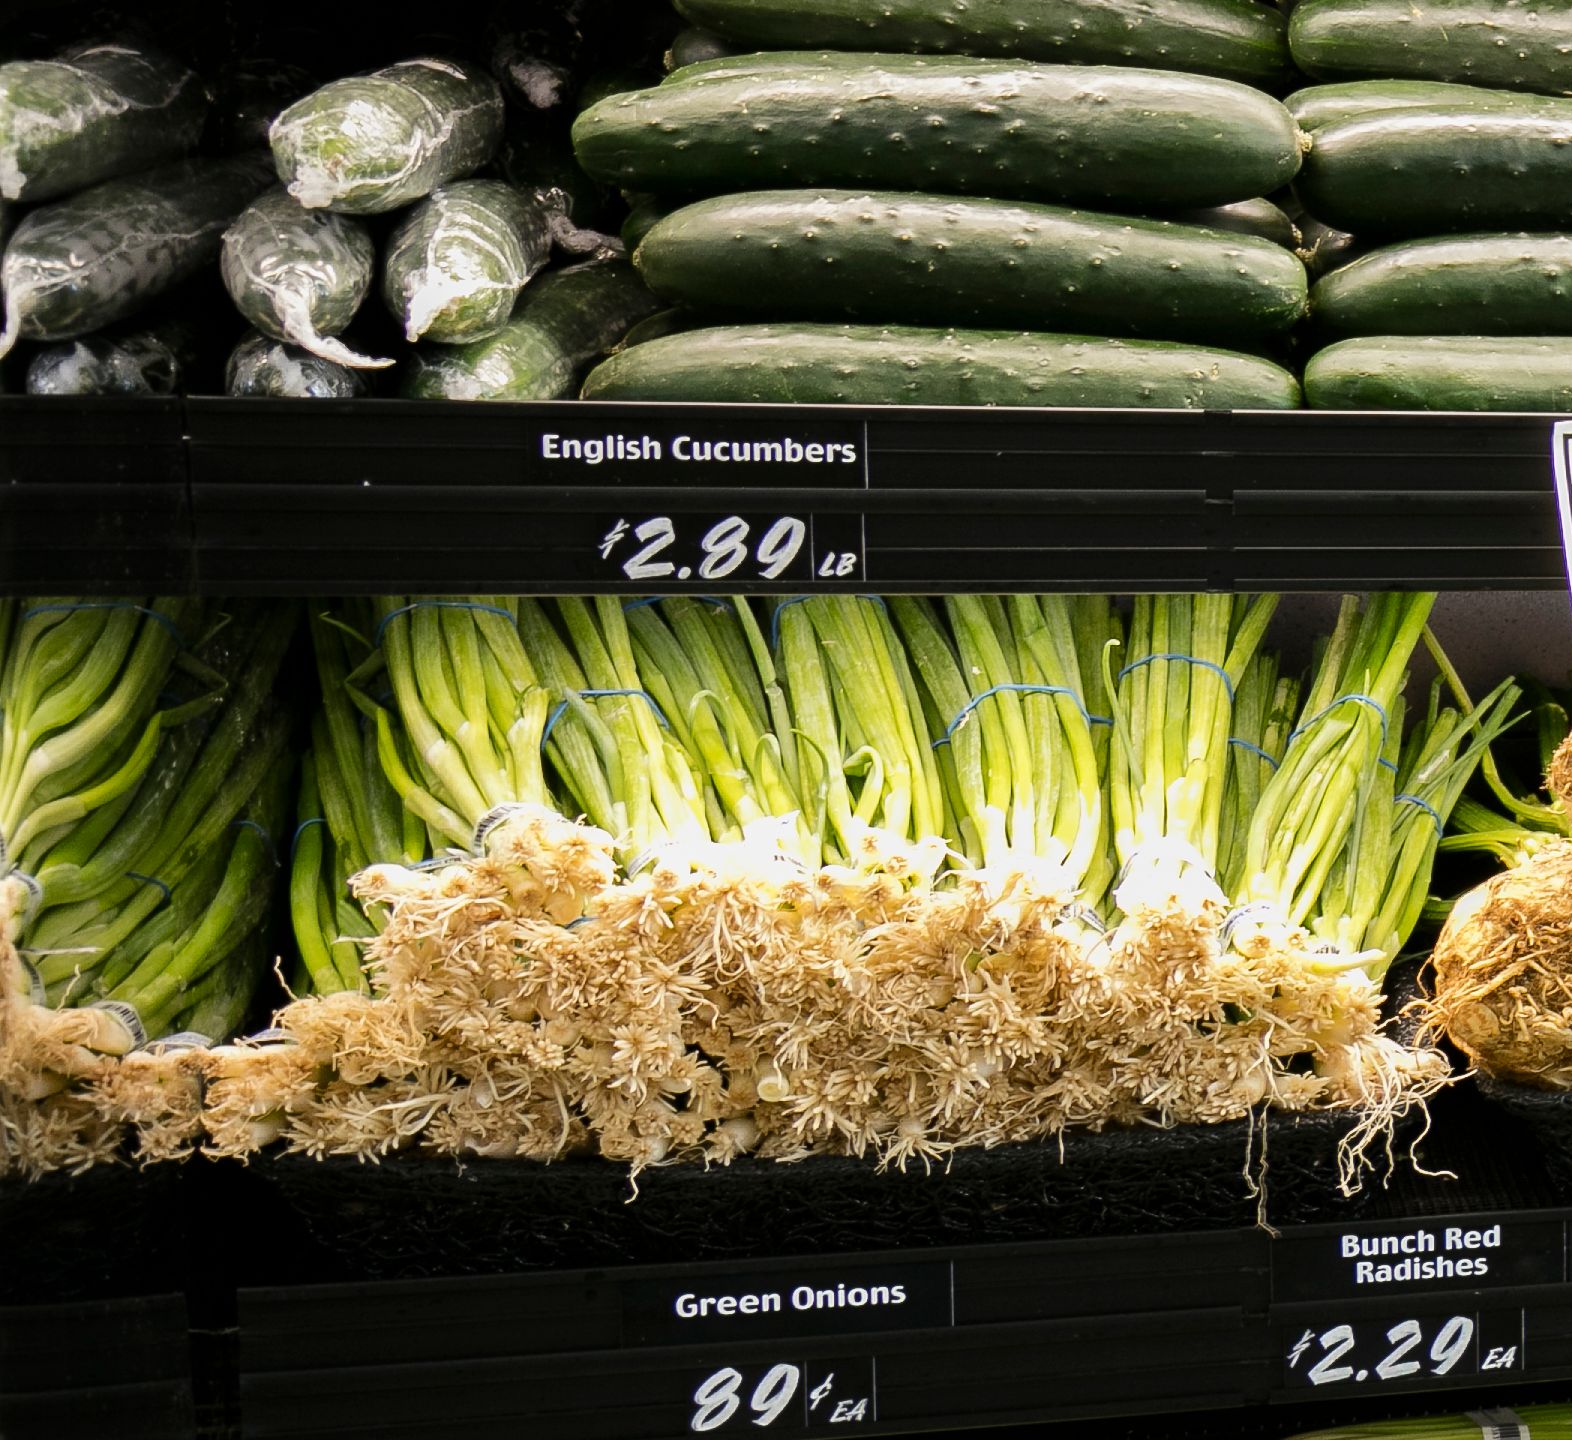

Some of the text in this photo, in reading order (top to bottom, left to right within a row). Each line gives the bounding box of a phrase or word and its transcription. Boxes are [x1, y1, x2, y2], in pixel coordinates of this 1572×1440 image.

[542, 434, 856, 465] English Cucumbers
[600, 516, 856, 580] $2.89 LB
[1341, 1226, 1502, 1259] Bunch Red
[1355, 1253, 1489, 1285] Radishes
[676, 1283, 907, 1319] Green Onions
